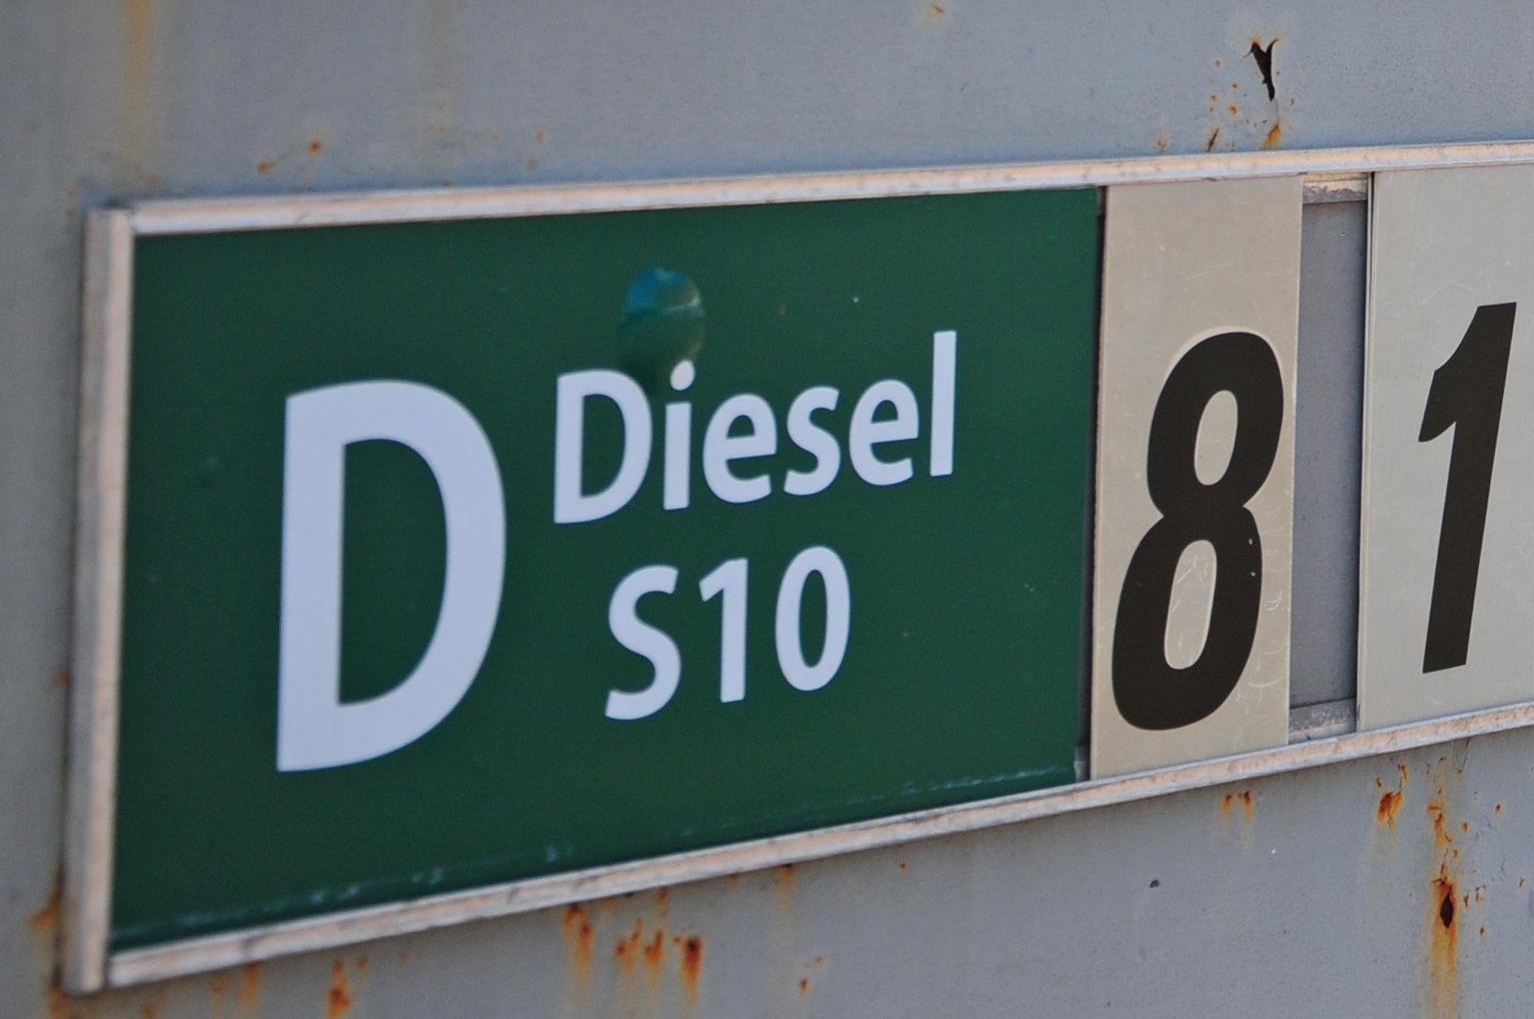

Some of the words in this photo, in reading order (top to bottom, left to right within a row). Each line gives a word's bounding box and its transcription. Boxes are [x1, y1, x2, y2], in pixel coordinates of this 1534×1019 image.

[554, 330, 958, 524] Diesel
[276, 379, 507, 772] D
[604, 545, 852, 721] S10
